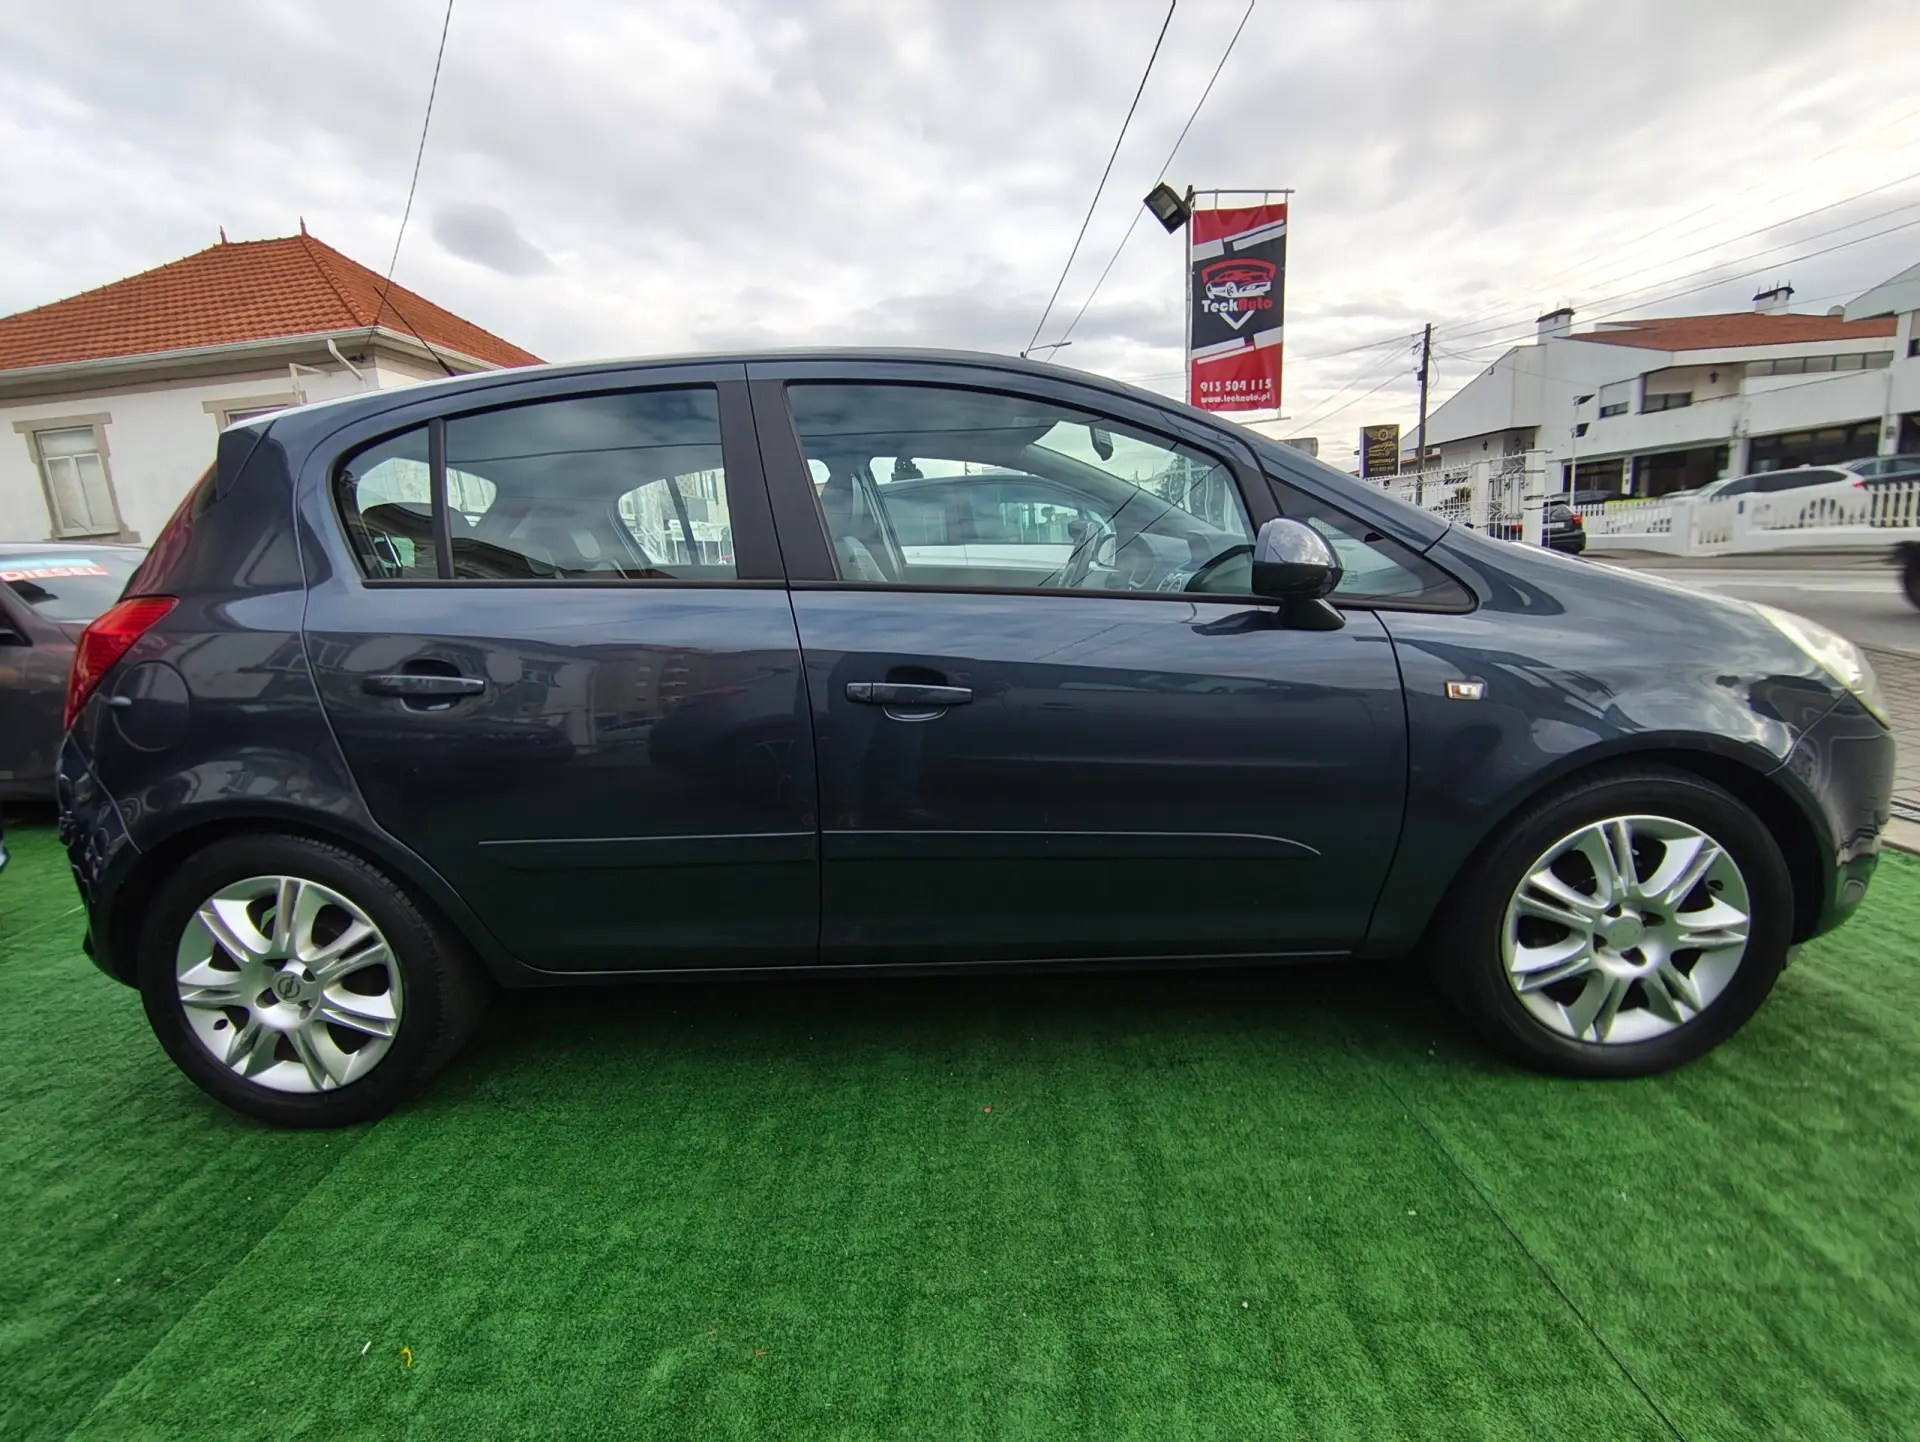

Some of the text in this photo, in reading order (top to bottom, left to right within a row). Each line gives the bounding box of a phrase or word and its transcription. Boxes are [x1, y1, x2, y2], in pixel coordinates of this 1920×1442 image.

[1201, 297, 1273, 313] TeckAuto
[1225, 380, 1247, 391] 504
[1250, 377, 1272, 389] 115
[0, 566, 109, 581] DIESEL
